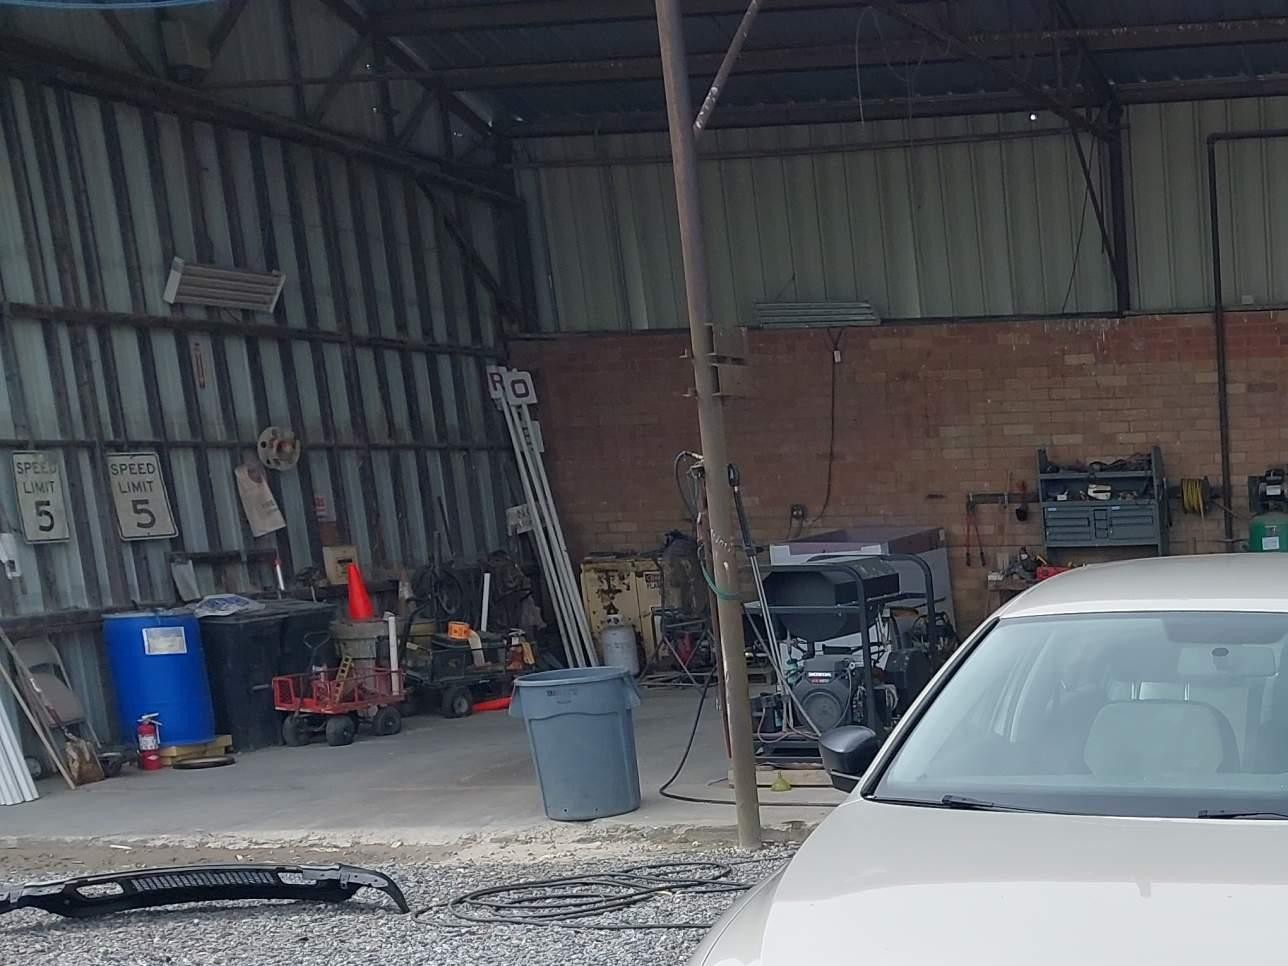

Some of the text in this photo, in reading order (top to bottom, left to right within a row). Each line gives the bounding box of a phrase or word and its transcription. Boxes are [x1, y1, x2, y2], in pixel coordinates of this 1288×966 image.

[16, 461, 57, 475] SPEED
[110, 462, 156, 475] SPEED
[22, 480, 55, 494] LIMIT
[117, 480, 154, 494] LIMIT
[34, 500, 55, 532] 5
[131, 499, 156, 529] 5
